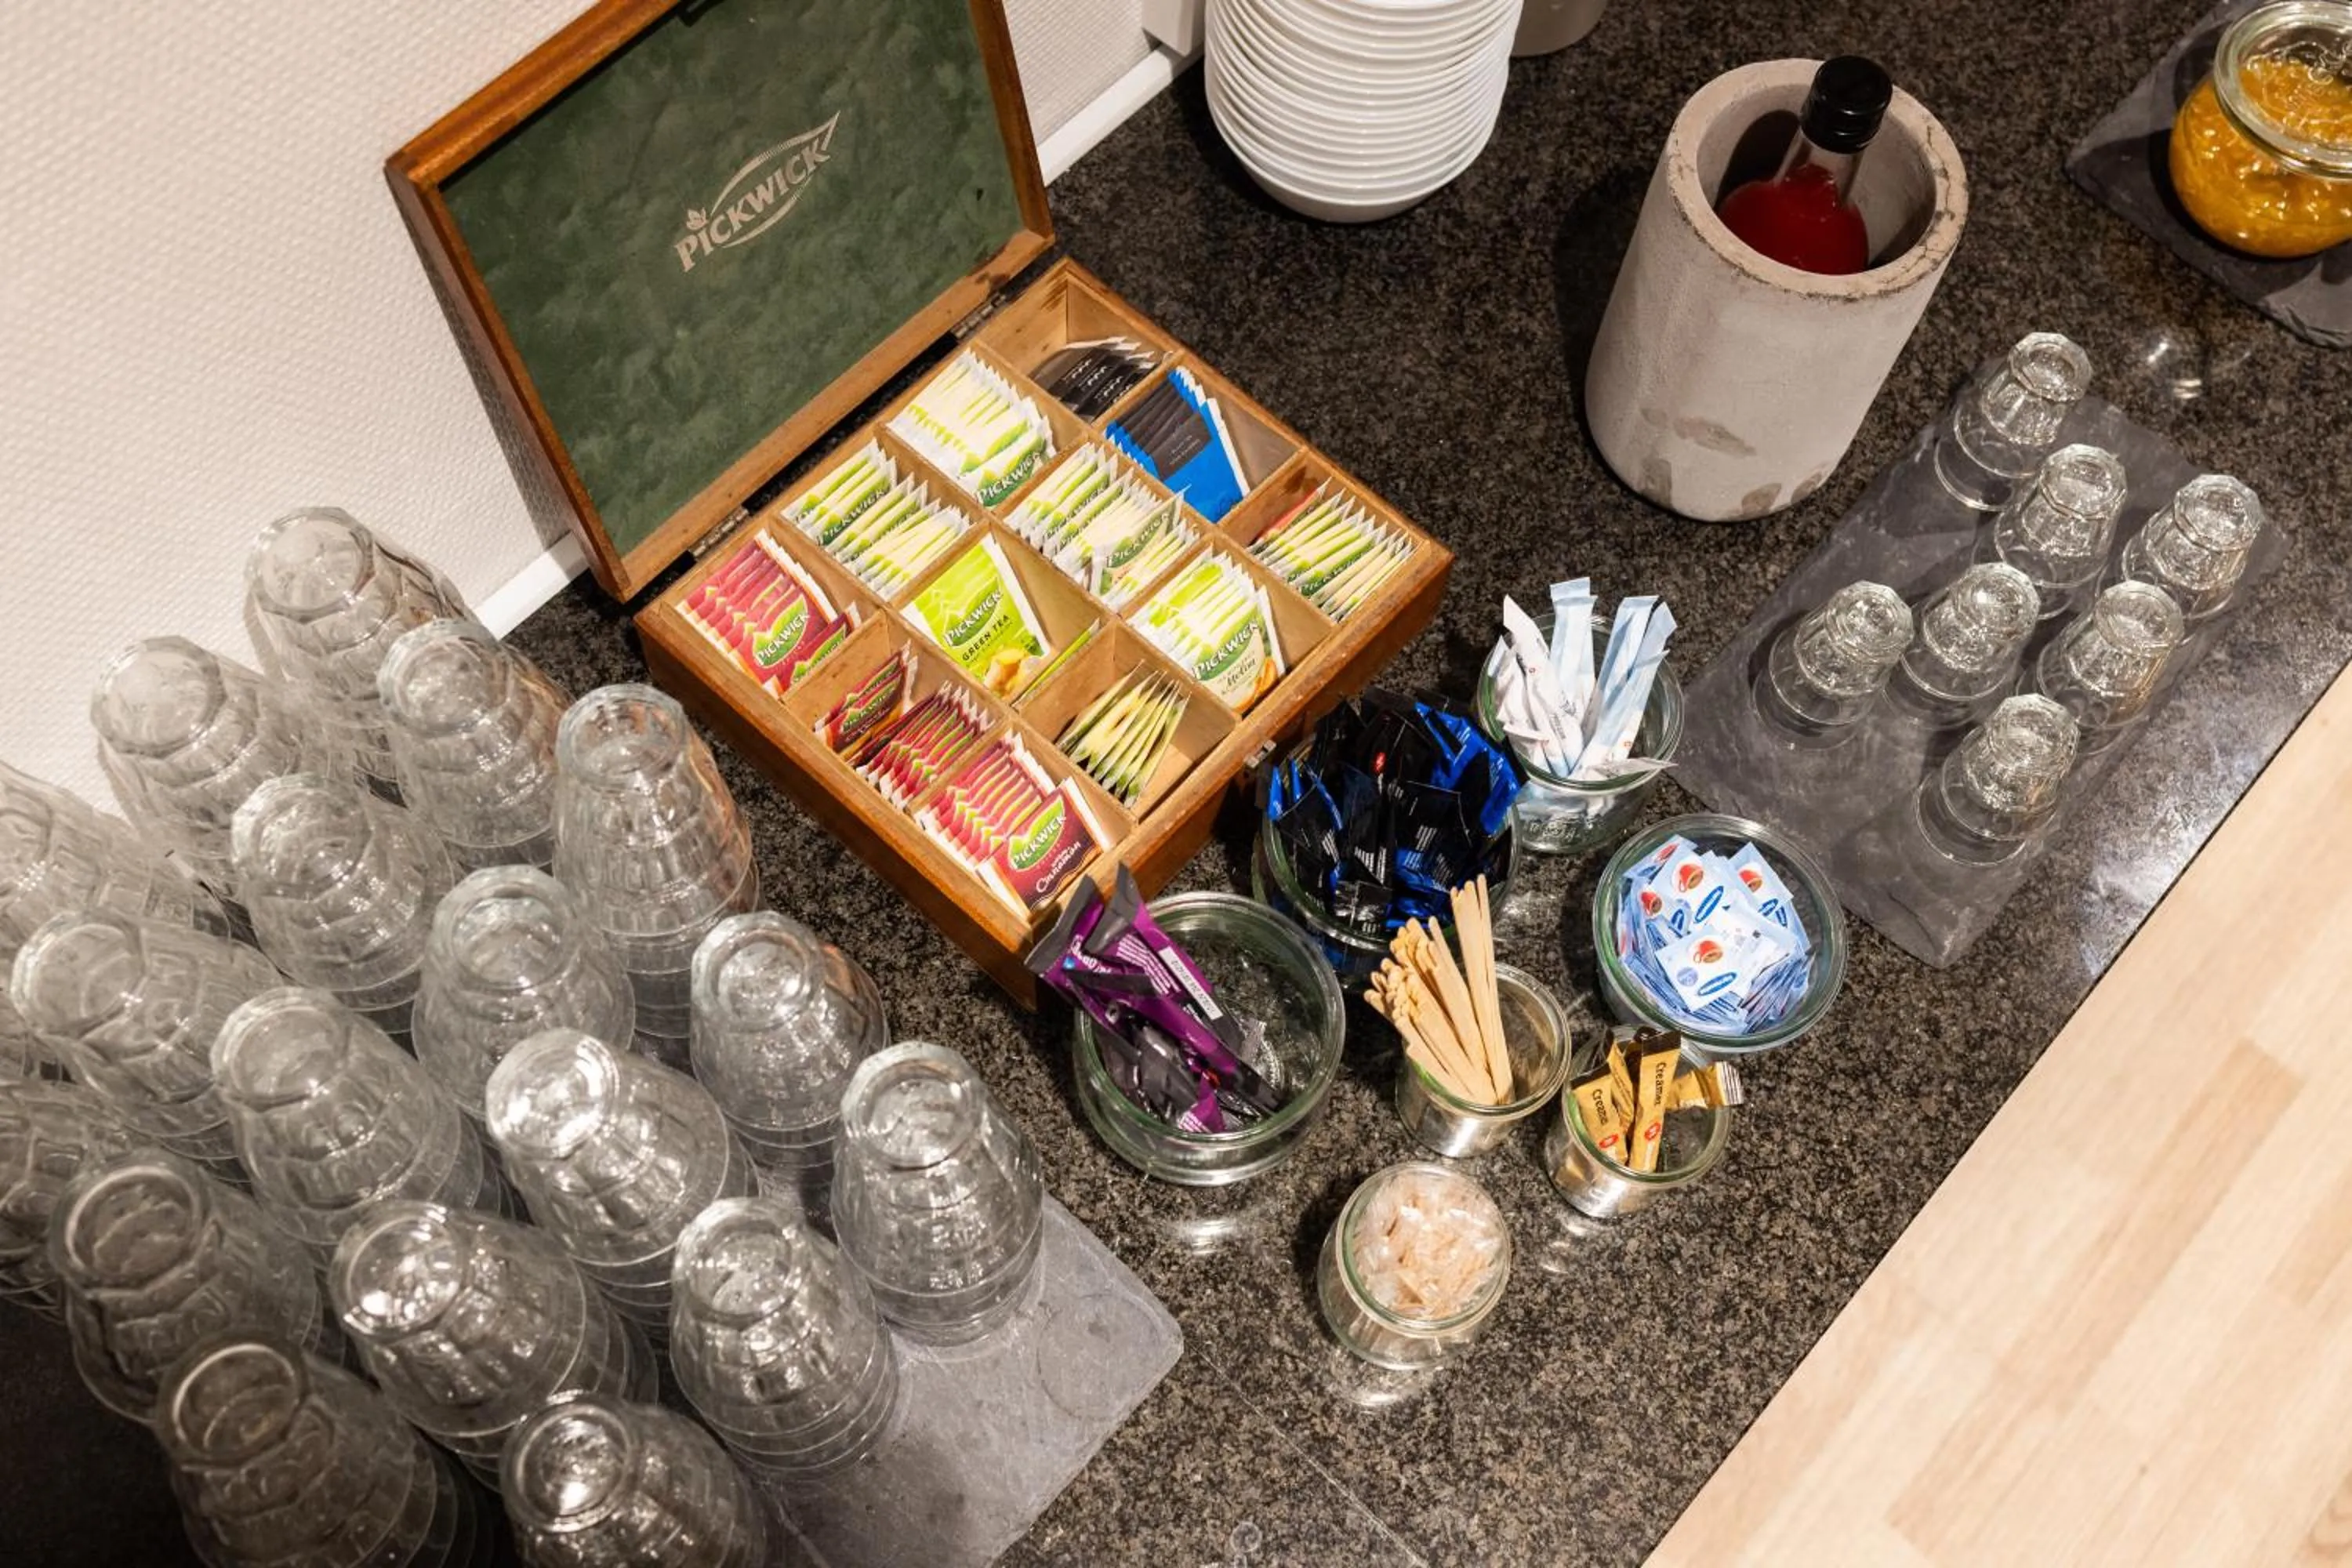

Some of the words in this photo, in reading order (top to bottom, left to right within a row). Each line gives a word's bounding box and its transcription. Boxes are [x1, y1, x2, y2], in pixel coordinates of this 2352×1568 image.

[673, 137, 832, 273] PICKWICK
[755, 612, 811, 666] PICKWICK
[943, 588, 1004, 647] PICKWICK
[961, 631, 991, 662] GREEN
[993, 614, 1010, 632] TEA
[1192, 619, 1258, 681] PICKWICK
[1011, 815, 1067, 871] PICKWICK
[1035, 840, 1082, 894] Cinnamon
